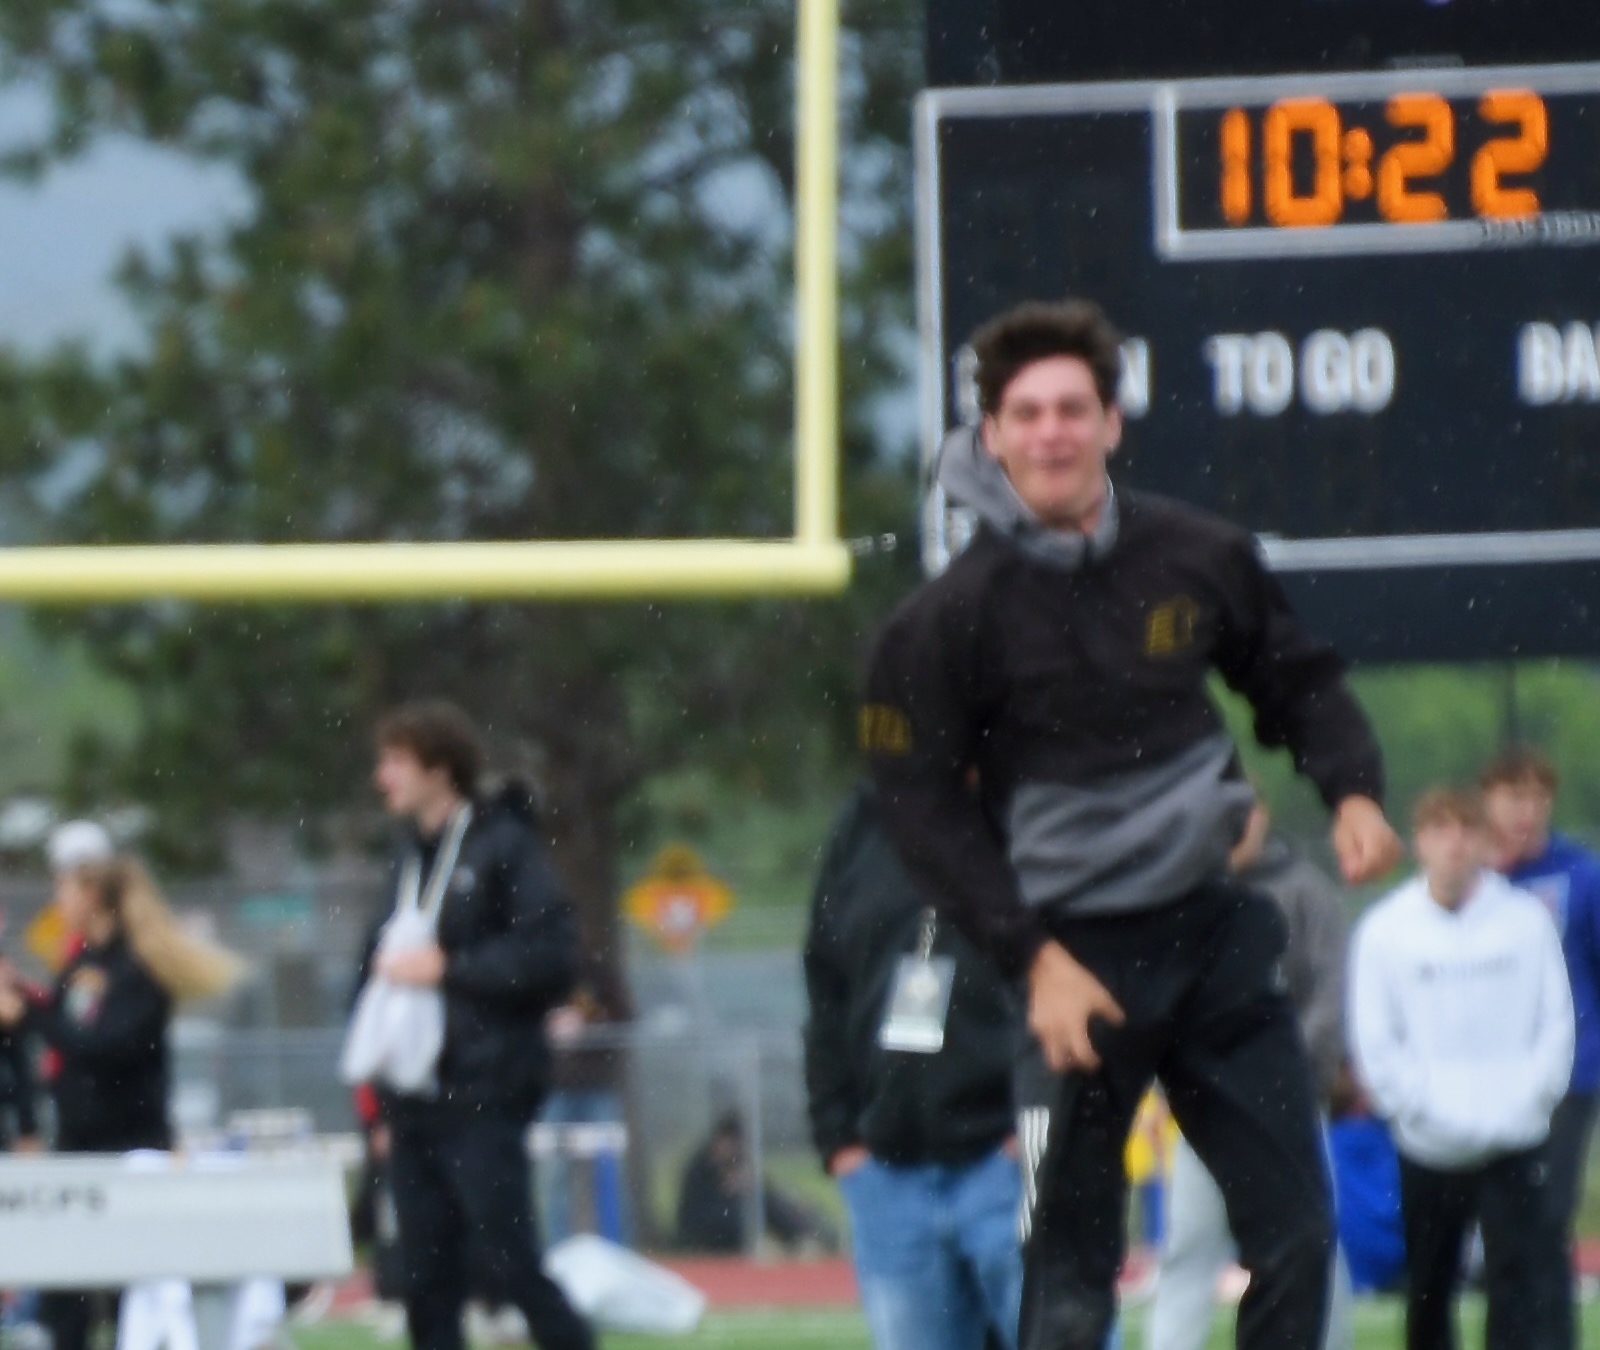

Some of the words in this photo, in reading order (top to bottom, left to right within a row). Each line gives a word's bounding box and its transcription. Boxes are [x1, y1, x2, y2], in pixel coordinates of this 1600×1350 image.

[1219, 88, 1549, 229] 10:22
[1205, 331, 1294, 414] TO
[1302, 327, 1396, 414] GO
[1518, 320, 1600, 406] BA
